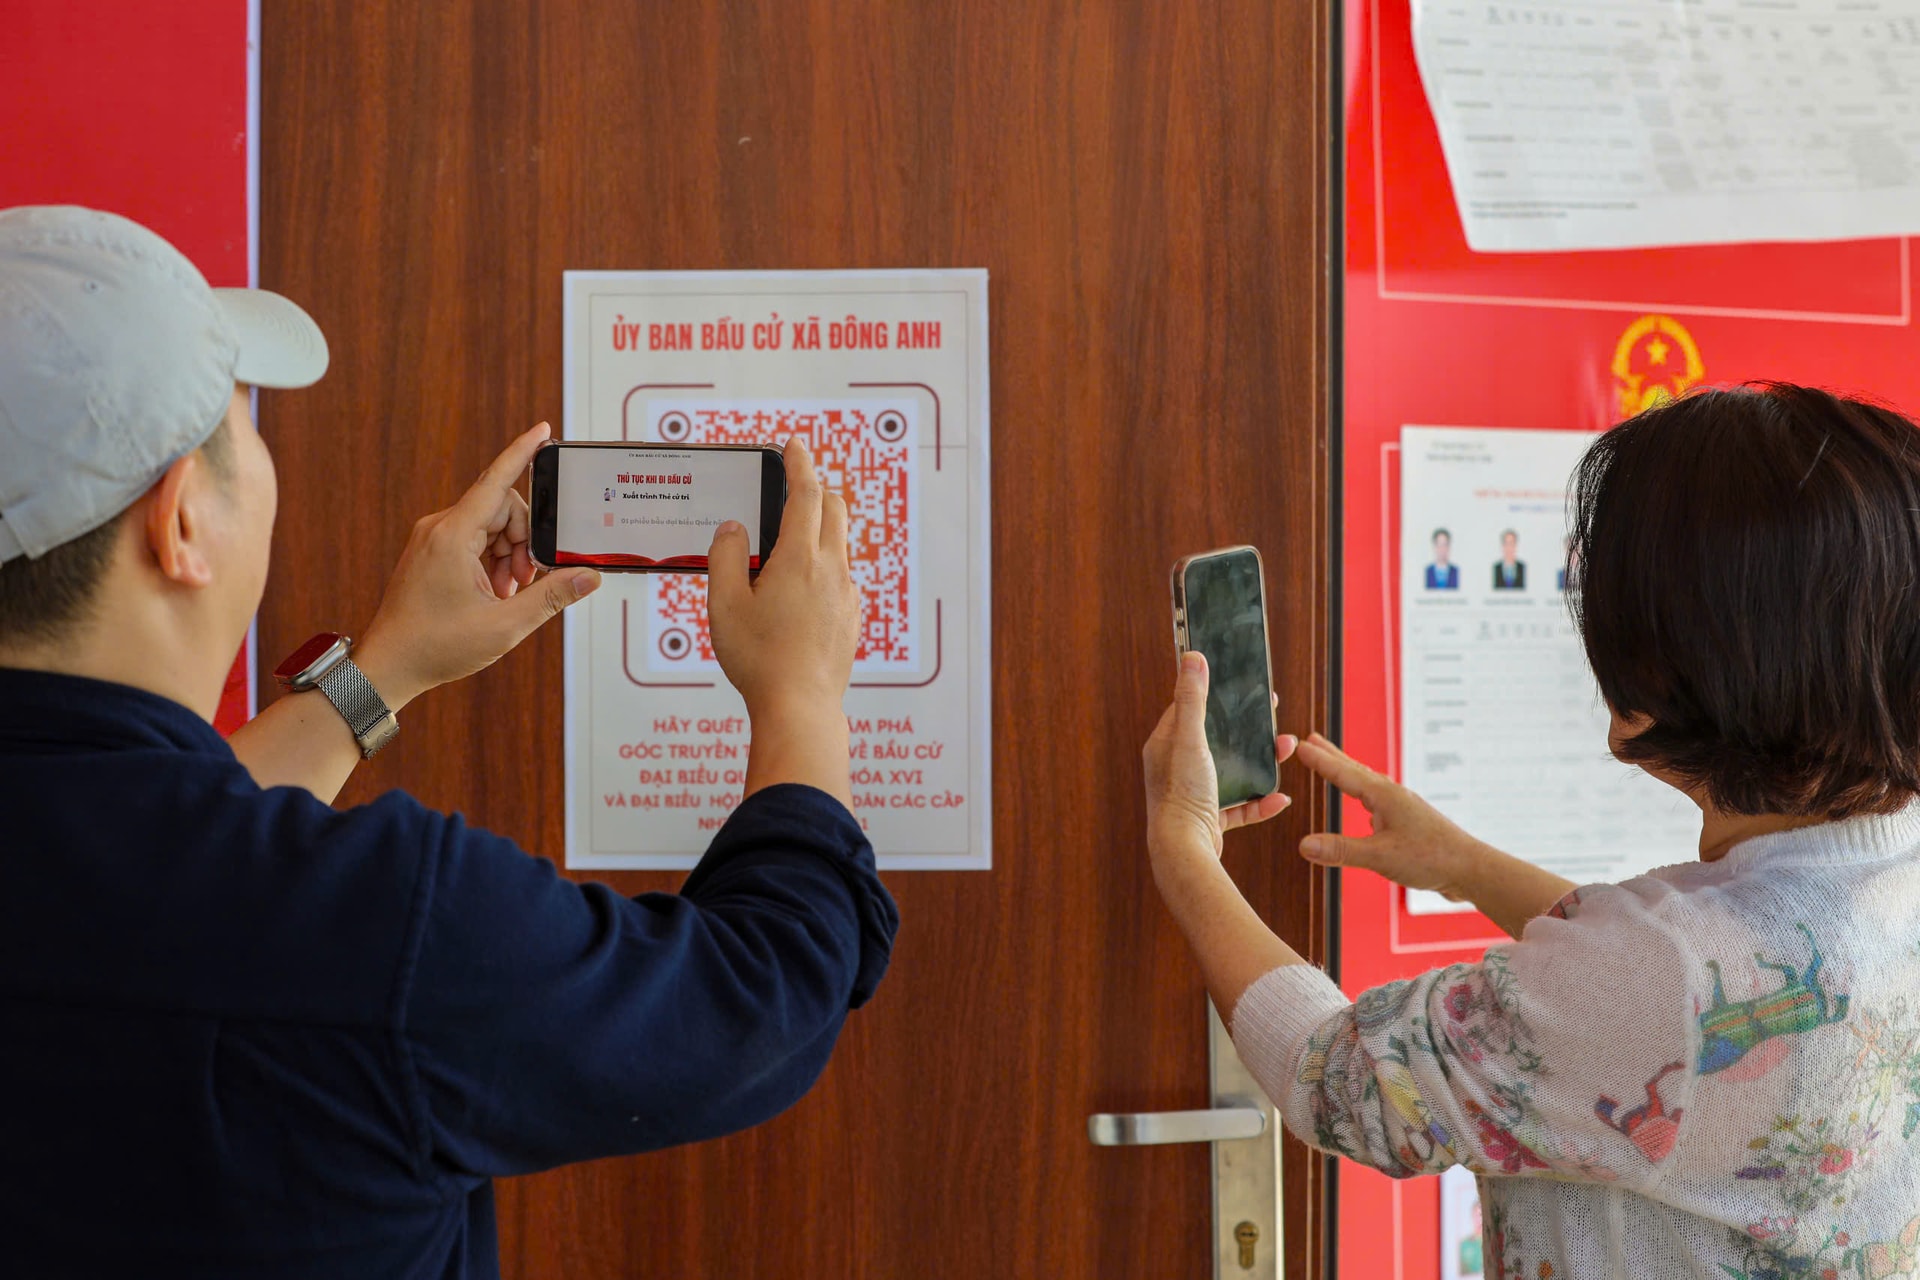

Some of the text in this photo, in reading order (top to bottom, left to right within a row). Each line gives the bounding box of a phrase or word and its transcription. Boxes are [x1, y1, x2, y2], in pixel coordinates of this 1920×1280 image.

[612, 314, 641, 351] ỦY
[648, 322, 693, 351] BAN
[752, 312, 784, 351] CỬ
[791, 316, 821, 350] XÃ
[829, 314, 888, 350] ĐÔNG
[896, 321, 941, 350] ANH
[617, 471, 630, 484] THỦ
[632, 474, 644, 486] TỤC
[645, 474, 657, 484] KHI
[658, 475, 666, 484] ĐI
[697, 716, 744, 734] QUÉT
[877, 715, 914, 734] PHÁ
[618, 740, 663, 760] GÓC
[667, 737, 738, 760] TRUYỀN
[639, 768, 673, 789] ĐẠI
[723, 769, 746, 785] QU
[889, 769, 924, 785] XVI
[603, 790, 627, 808] VÀ
[630, 793, 660, 812] ĐẠI
[889, 791, 926, 809] CÁC
